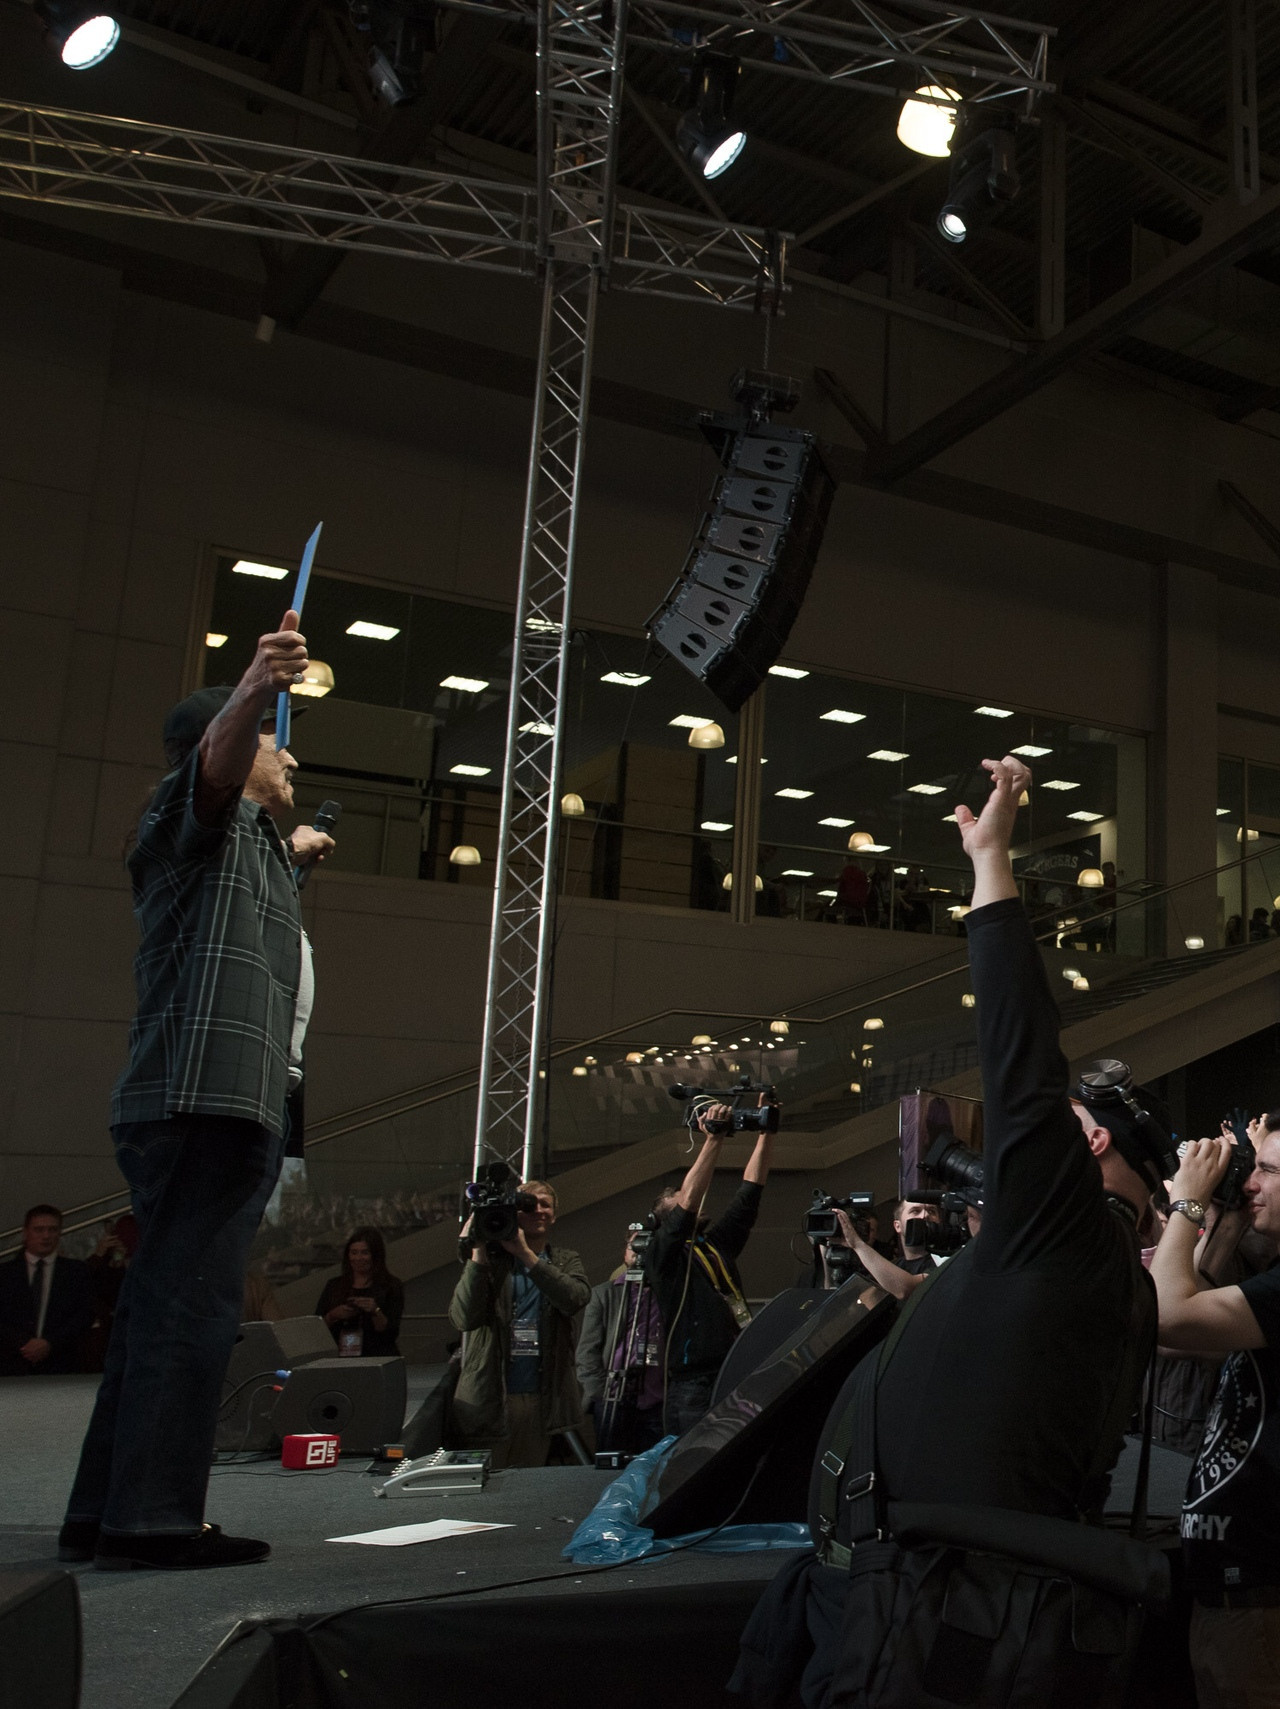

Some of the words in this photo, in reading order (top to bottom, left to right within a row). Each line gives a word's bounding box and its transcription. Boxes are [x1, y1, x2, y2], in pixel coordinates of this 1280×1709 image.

[326, 1440, 337, 1464] LIFE
[1195, 1437, 1249, 1494] 1988
[1180, 1513, 1232, 1541] RCHY
